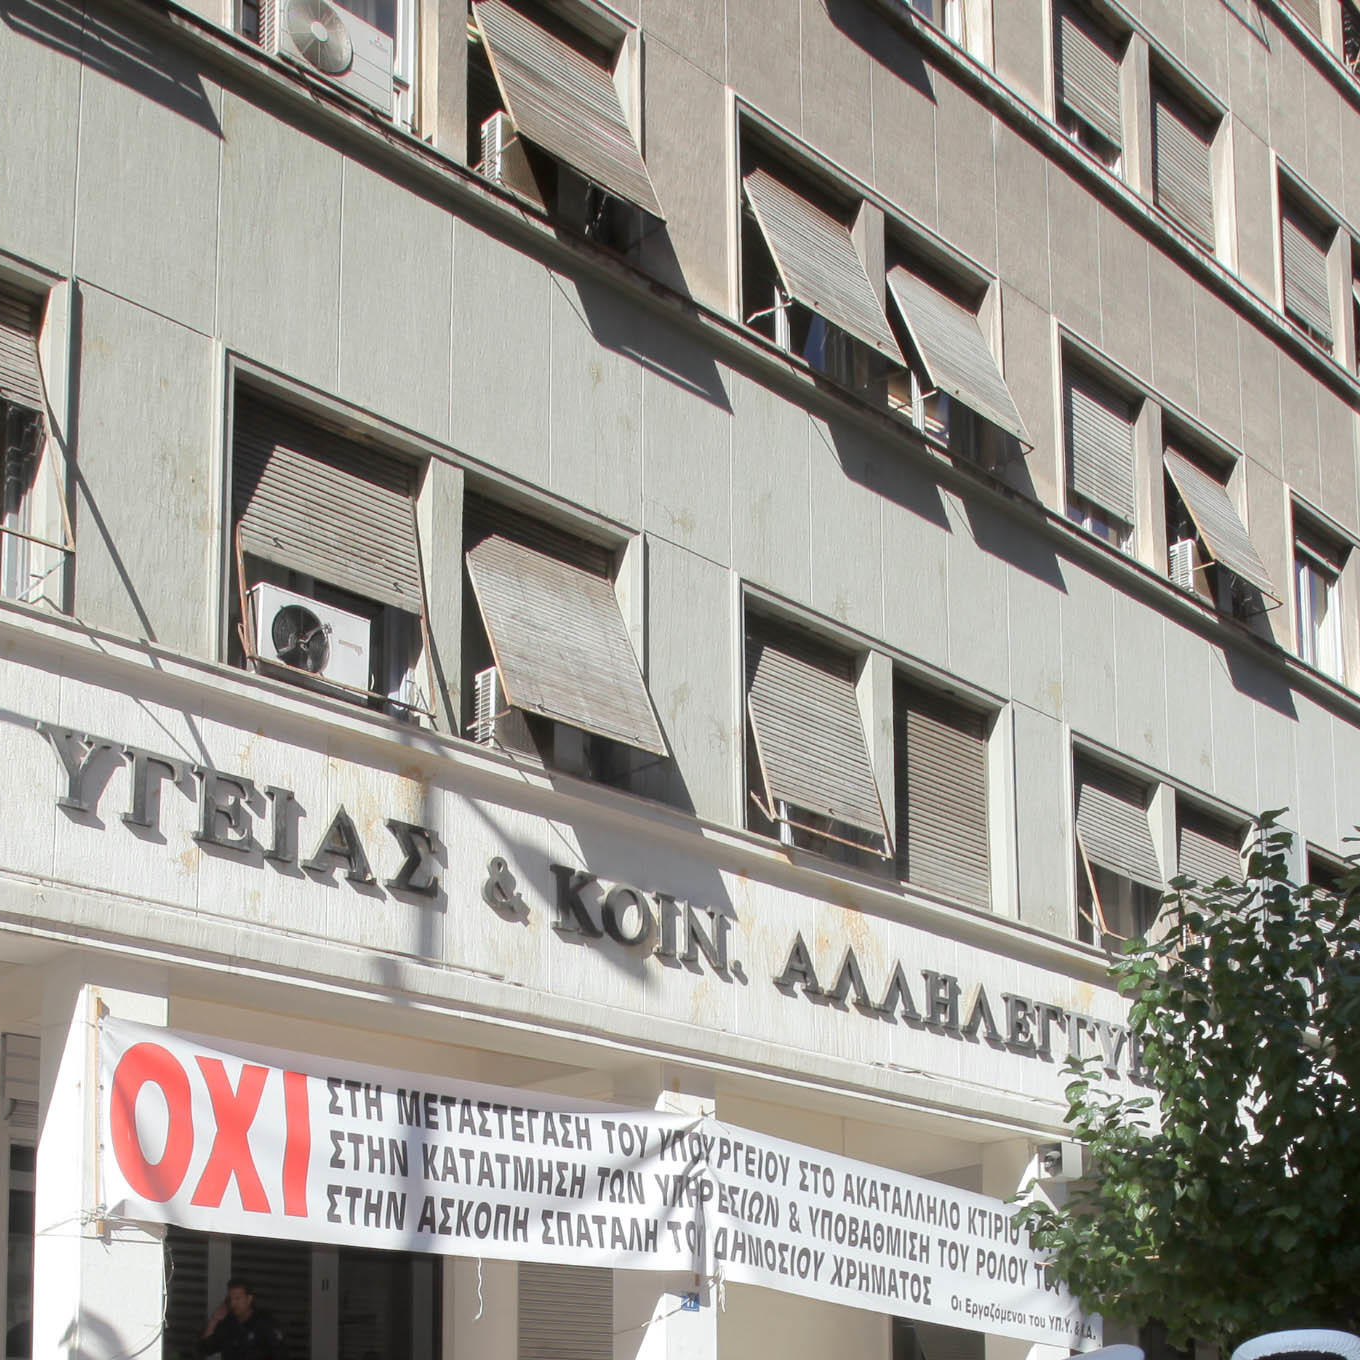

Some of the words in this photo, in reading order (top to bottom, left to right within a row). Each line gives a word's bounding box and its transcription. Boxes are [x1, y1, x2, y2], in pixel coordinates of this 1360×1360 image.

[36, 721, 439, 898] ΥΓΕΙΑΣ
[481, 856, 524, 912] &
[549, 863, 743, 976] ΚΟΙΝ.
[110, 1041, 311, 1218] ΟΧΙ
[327, 1077, 382, 1122] ΣΤΗ
[397, 1089, 591, 1151] ΜΕΤΑΣΤΕΓΑΣΗ
[602, 1121, 649, 1159] ΤΟΥ
[658, 1128, 790, 1186] ΥΠΟΥΡΓΕΙΟΥ
[799, 1160, 835, 1199] ΣΤΟ
[843, 1173, 960, 1231] ΑΚΑΤΑΛΛΗΛΟ
[326, 1184, 406, 1231] ΣΤΗΝ
[418, 1195, 529, 1243] ΑΣΚΟΠΗ
[541, 1210, 658, 1253] ΣΠΑΤΑΛΗ
[714, 1227, 825, 1281] ΔΗΜΟΣΙΟΥ
[830, 1255, 932, 1305] ΧΡΗΜΑΤΟΣ
[329, 1131, 408, 1176] ΣΤΗΝ
[423, 1143, 586, 1200] ΚΑΤΑΤΜΗΣΗ
[597, 1167, 644, 1204] ΤΩΝ
[654, 1174, 779, 1228] ΥΠΗΡΕΣΙΩΝ
[789, 1201, 802, 1233] &
[809, 1206, 930, 1265] ΥΠΟΒΑΘΜΙΣΗ
[938, 1238, 969, 1272] ΤΟΥ
[977, 1248, 1028, 1286] ΡΟΛΟΥ
[951, 1295, 963, 1311] Οι
[965, 1296, 1026, 1324] Εργαζόμενοι
[1030, 1315, 1045, 1328] του
